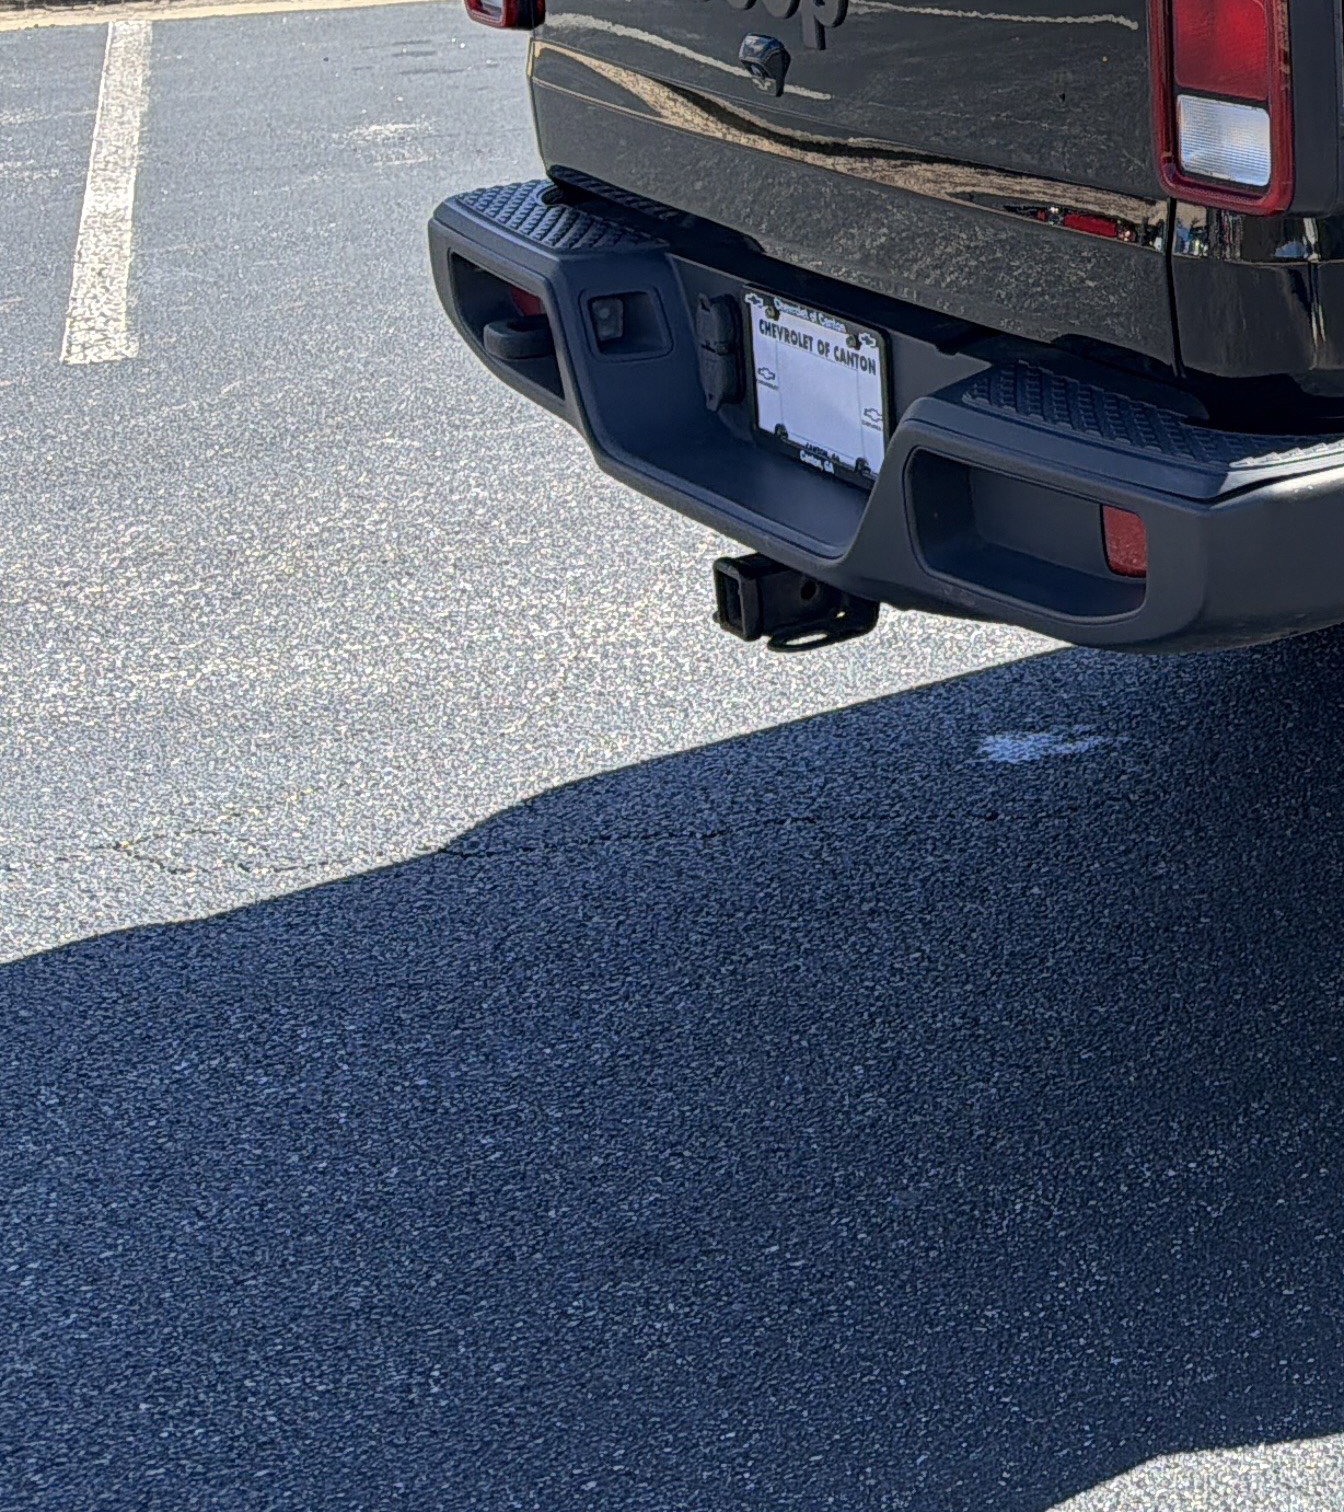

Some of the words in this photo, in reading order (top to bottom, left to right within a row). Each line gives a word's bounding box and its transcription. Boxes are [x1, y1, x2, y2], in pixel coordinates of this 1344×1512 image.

[759, 319, 814, 352] CHEVROLET
[817, 339, 830, 358] OF
[834, 345, 877, 376] CANTON
